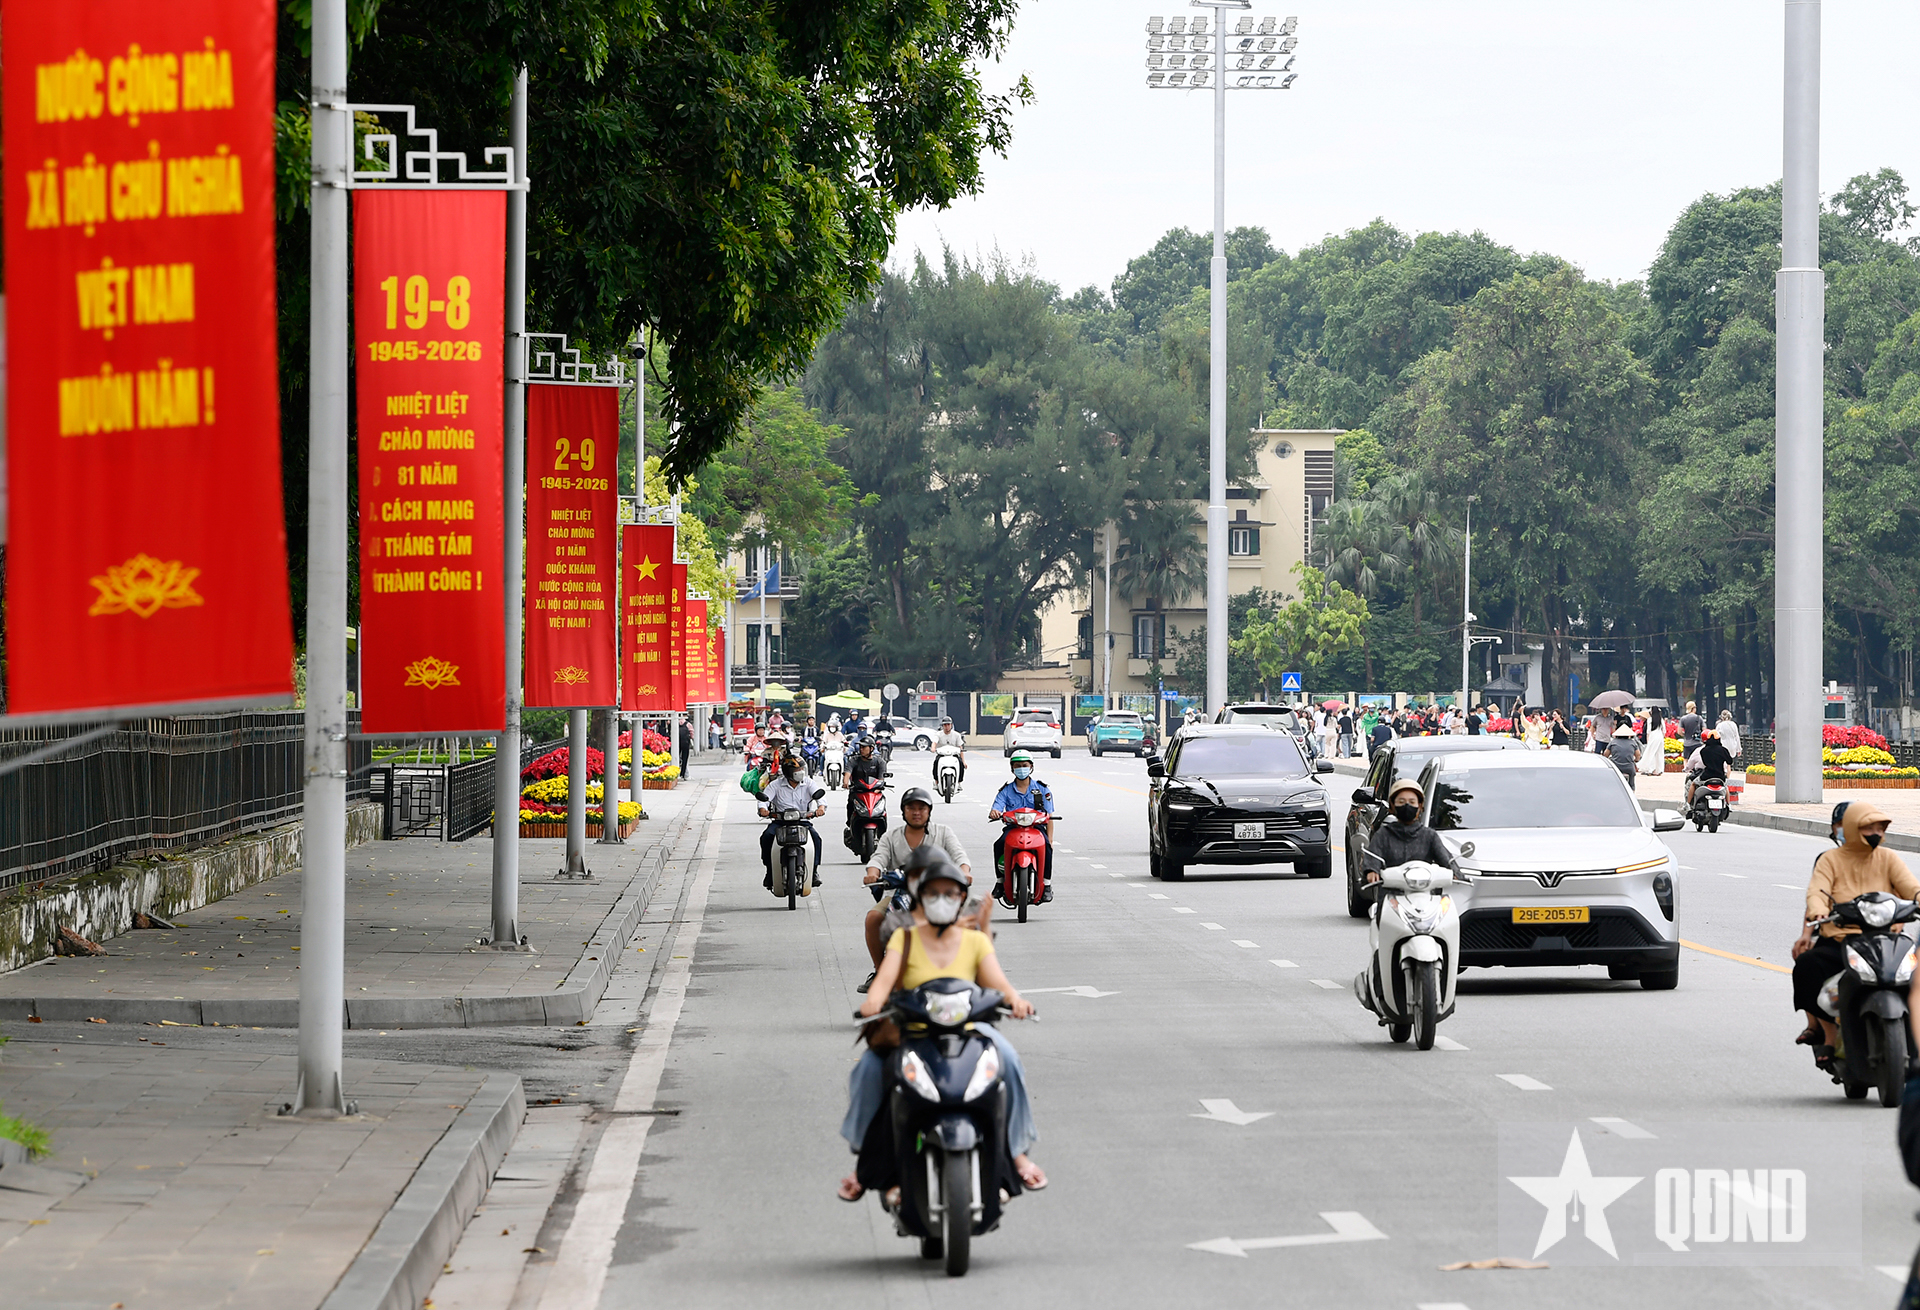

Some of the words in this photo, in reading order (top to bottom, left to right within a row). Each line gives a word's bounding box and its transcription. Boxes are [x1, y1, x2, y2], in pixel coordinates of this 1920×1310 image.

[36, 49, 104, 123] NƯỚC
[108, 43, 179, 127] CỘNG
[182, 37, 234, 111] HÒA
[27, 158, 60, 229] XÃ
[64, 153, 107, 237] HỘI
[111, 140, 163, 221] CHỦ
[167, 145, 243, 217] NGHĨA
[76, 256, 130, 340] VIỆT
[133, 263, 194, 324] NAM
[381, 275, 471, 330] 19-8
[368, 340, 482, 361] 1945-2026
[59, 363, 134, 437] MUÔN
[137, 359, 199, 429] NĂM
[203, 367, 215, 425] !
[387, 391, 432, 419] NHIỆT
[436, 391, 469, 418] LIỆT
[379, 426, 422, 451] CHÀO
[427, 426, 475, 449] MỪNG
[555, 438, 595, 471] 2-9
[398, 466, 414, 485] 81
[420, 461, 457, 485] NĂM
[540, 477, 608, 490] 1945-2026
[382, 498, 422, 522] CÁCH
[427, 500, 474, 524] MẠNG
[551, 508, 574, 522] NHIỆT
[576, 508, 592, 522] LIỆT
[548, 526, 569, 538] CHÀO
[571, 526, 594, 538] MỪNG
[384, 532, 434, 557] THÁNG
[438, 532, 472, 555] TÁM
[556, 546, 565, 556] 81
[568, 544, 586, 556] NĂM
[374, 569, 425, 593] THÀNH
[429, 567, 471, 591] CÔNG
[477, 571, 482, 591] !
[546, 561, 567, 575] QUỐC
[569, 562, 595, 574] KHÁNH
[539, 580, 560, 592] NƯỚC
[562, 580, 584, 594] CỘNG
[586, 580, 601, 592] HÒA
[535, 597, 546, 609] XÃ
[548, 598, 561, 612] HỘI
[563, 597, 579, 610] CHỦ
[581, 598, 604, 610] NGHĨA
[549, 616, 565, 630] VIỆT
[567, 618, 585, 628] NAM
[588, 618, 591, 628] !
[686, 616, 700, 627] 2-9
